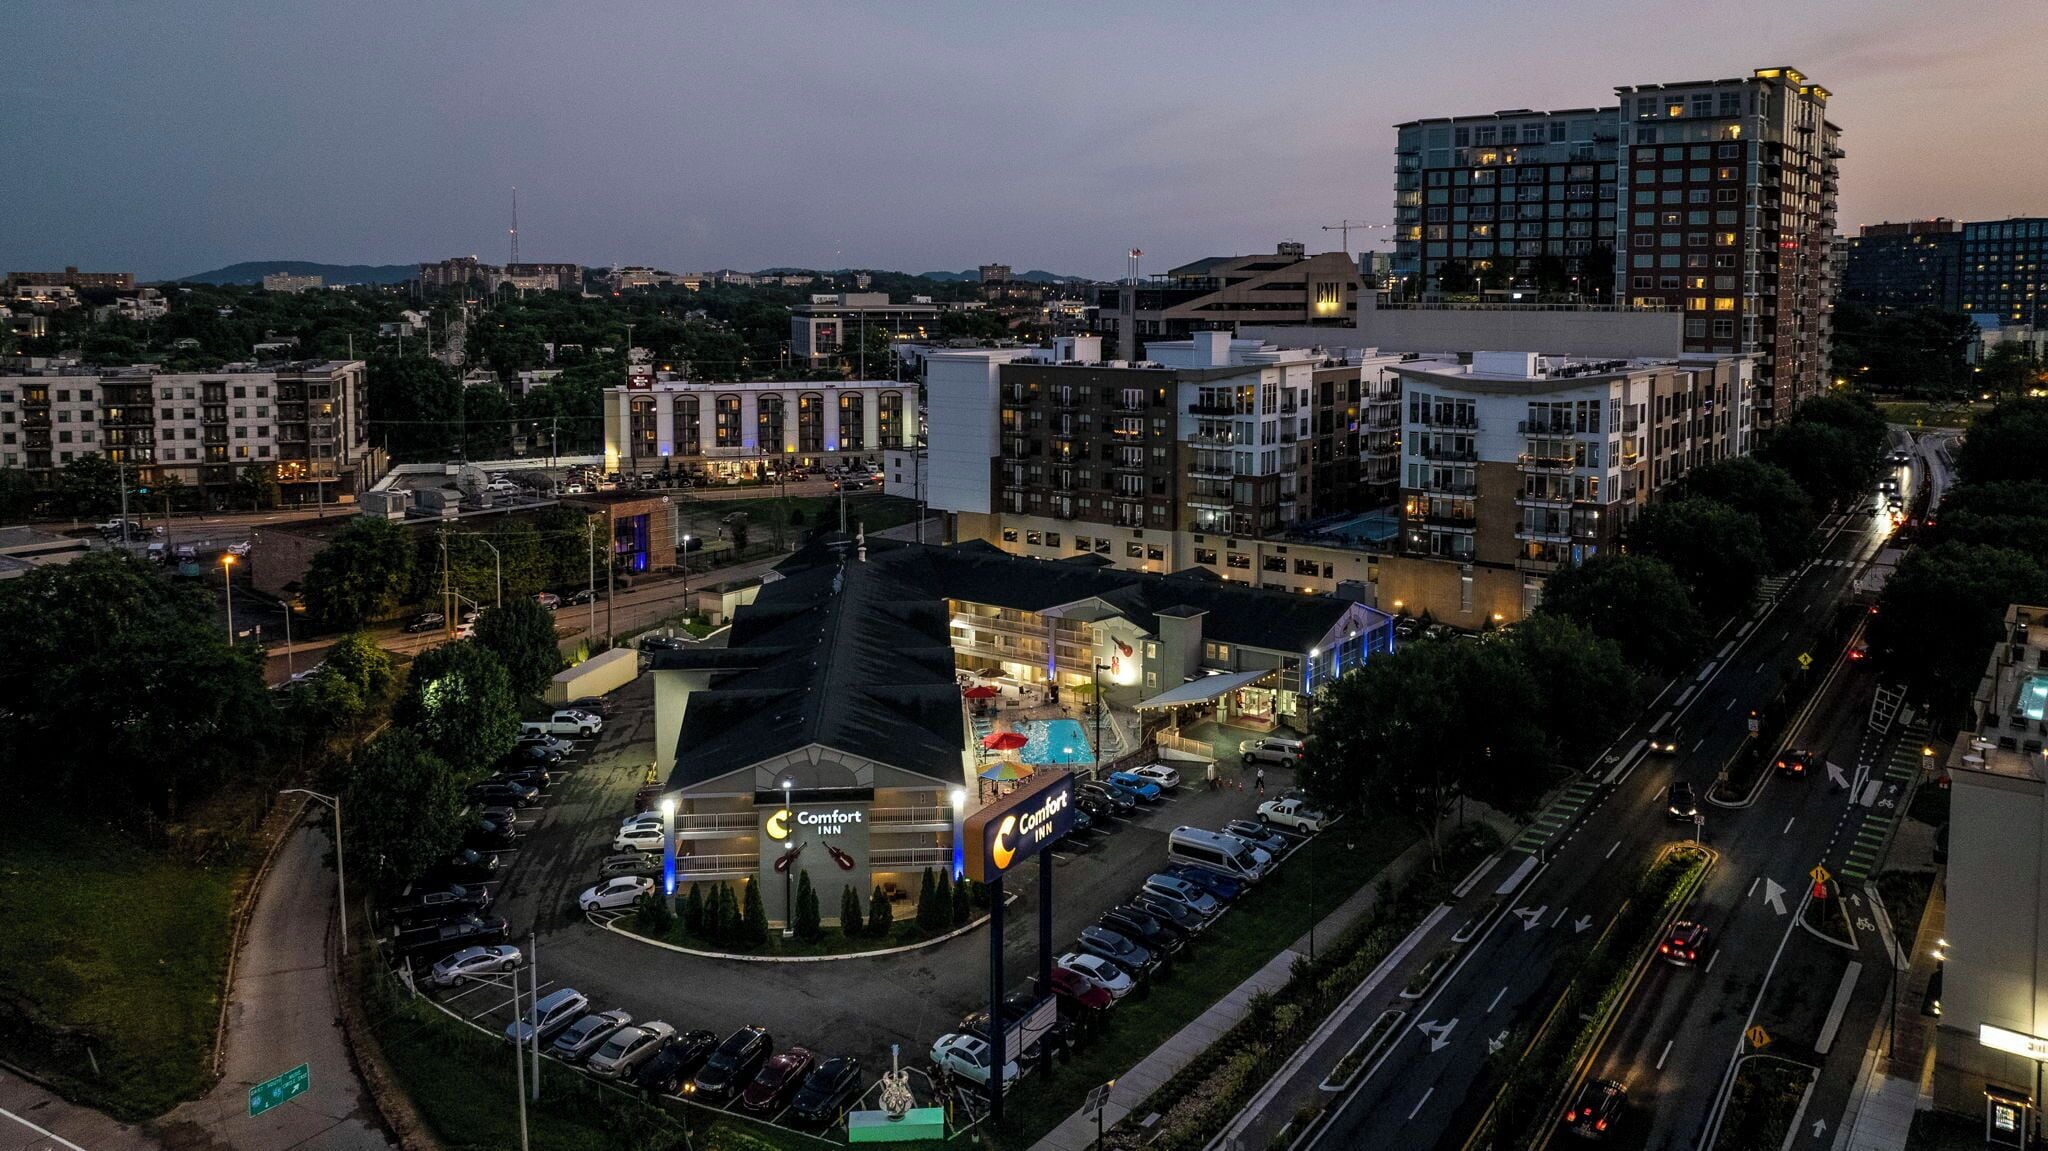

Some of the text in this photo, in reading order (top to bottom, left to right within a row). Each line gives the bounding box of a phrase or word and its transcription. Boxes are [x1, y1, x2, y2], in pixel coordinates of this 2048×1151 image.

[1316, 282, 1340, 303] BMI
[797, 809, 862, 825] Comfort
[1019, 790, 1068, 835] Comfort
[817, 825, 841, 835] INN
[1035, 821, 1053, 843] INN
